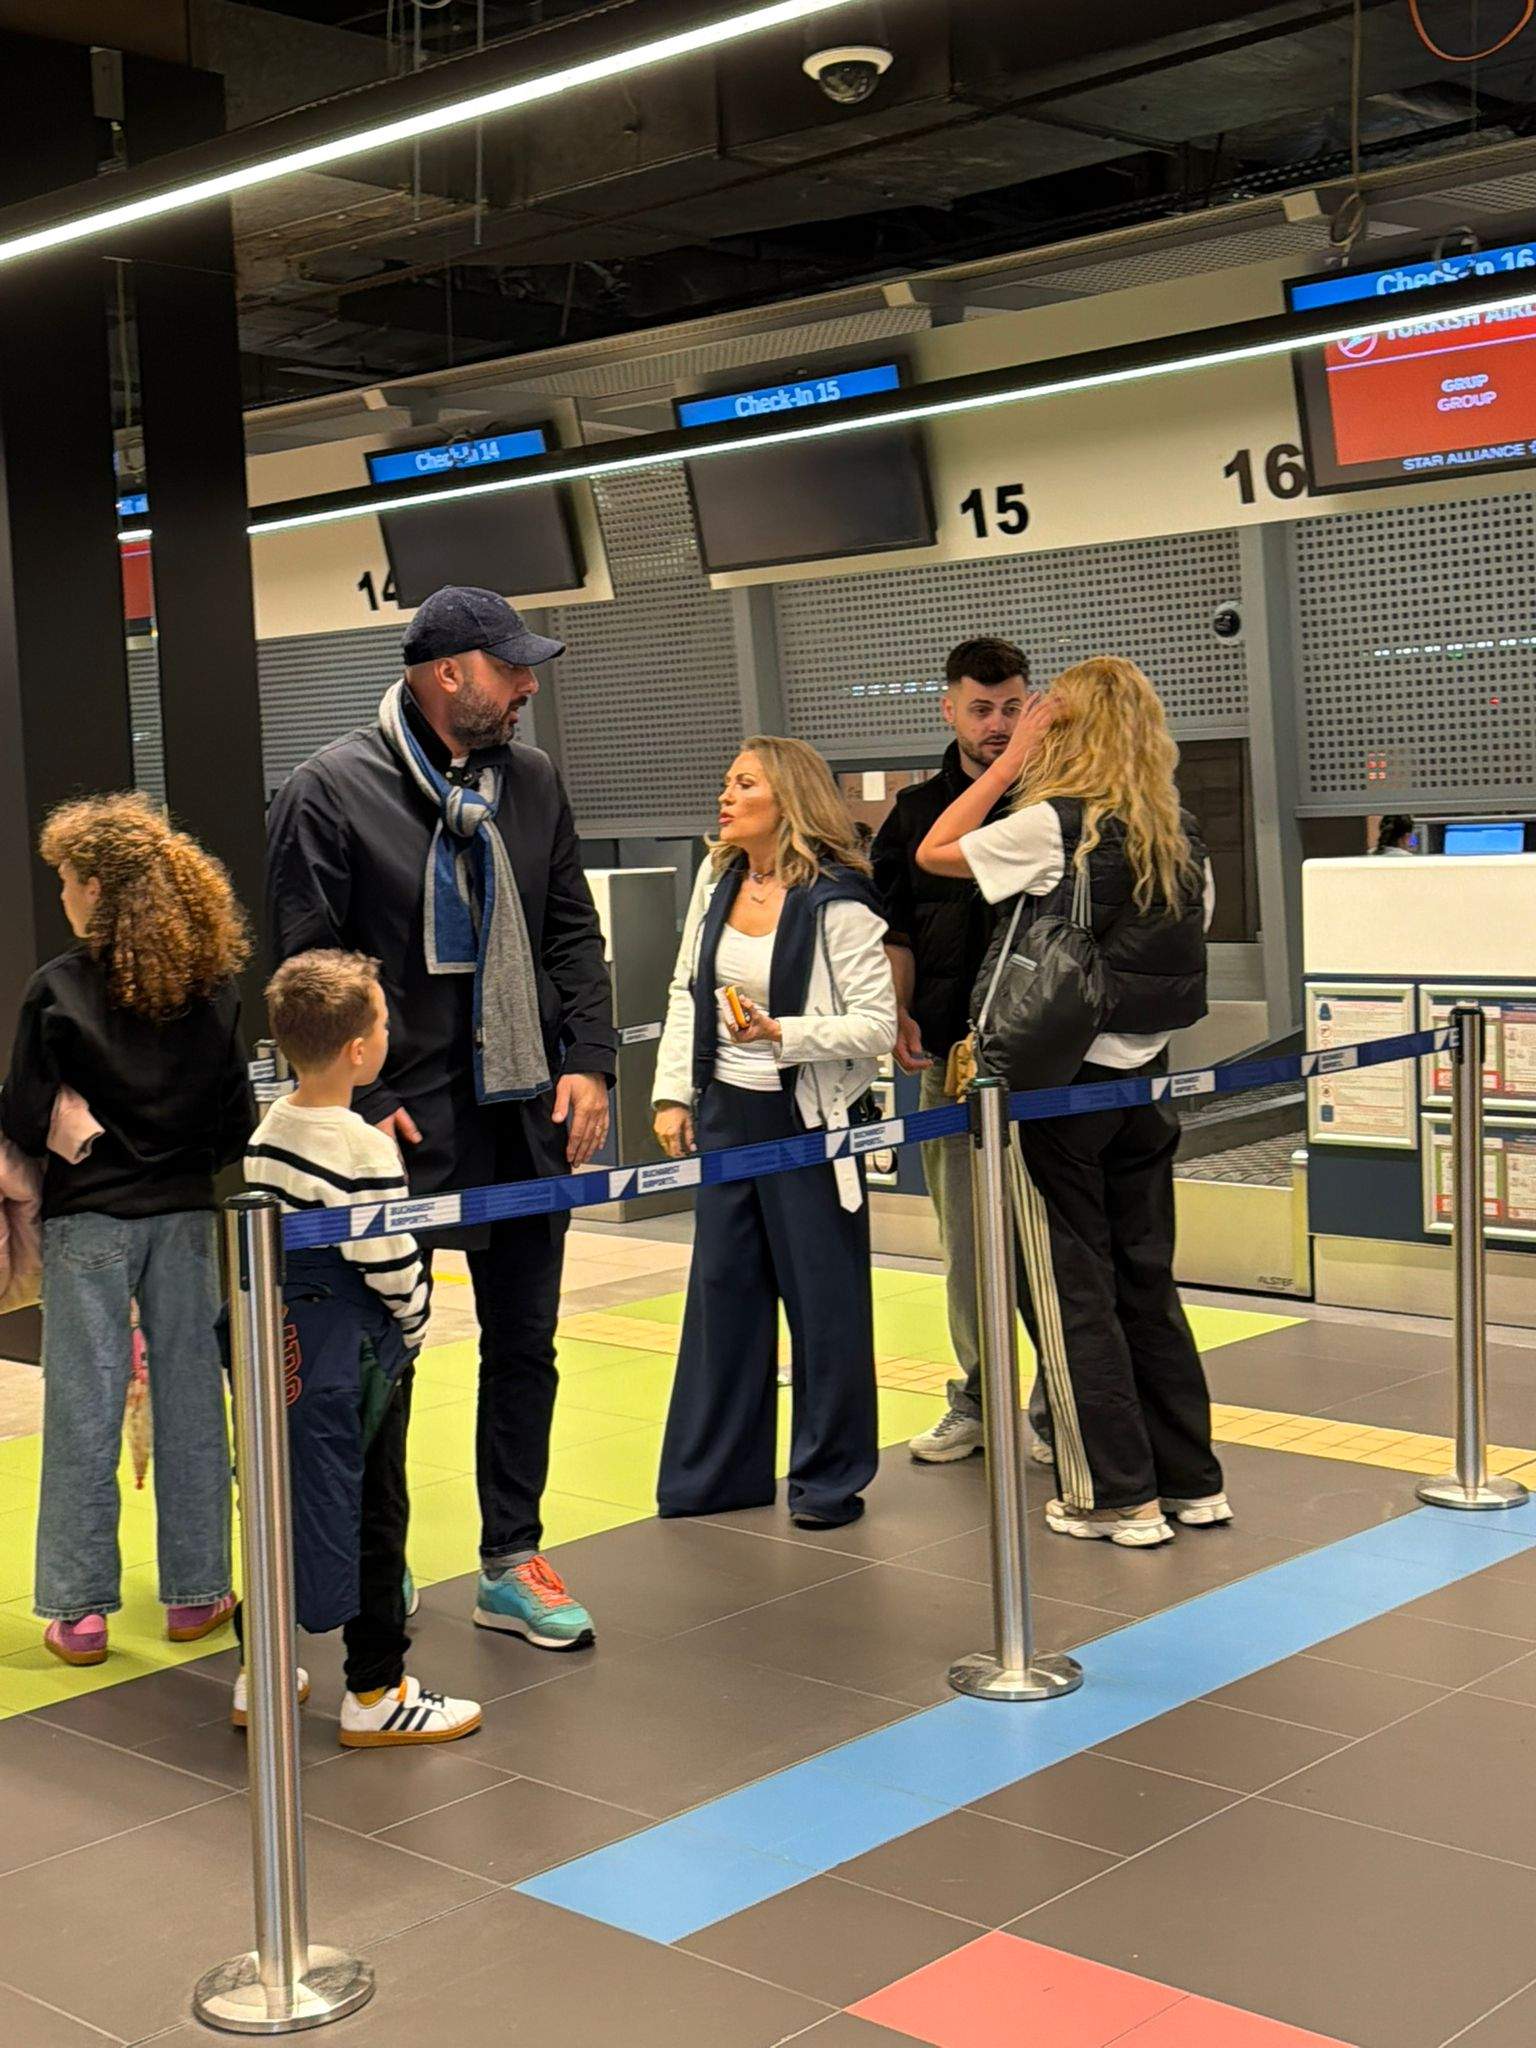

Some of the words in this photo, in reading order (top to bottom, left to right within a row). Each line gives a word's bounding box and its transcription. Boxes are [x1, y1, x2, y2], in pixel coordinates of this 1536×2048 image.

[1501, 248, 1536, 270] 16
[1441, 374, 1489, 392] GRUP
[735, 387, 815, 417] Check-In
[816, 380, 840, 403] 15
[1437, 391, 1497, 411] GROUP
[480, 441, 499, 462] 14
[1403, 455, 1444, 471] STAR
[1446, 444, 1526, 465] ALLIANCE
[1224, 444, 1307, 503] 16
[960, 483, 1029, 538] 15
